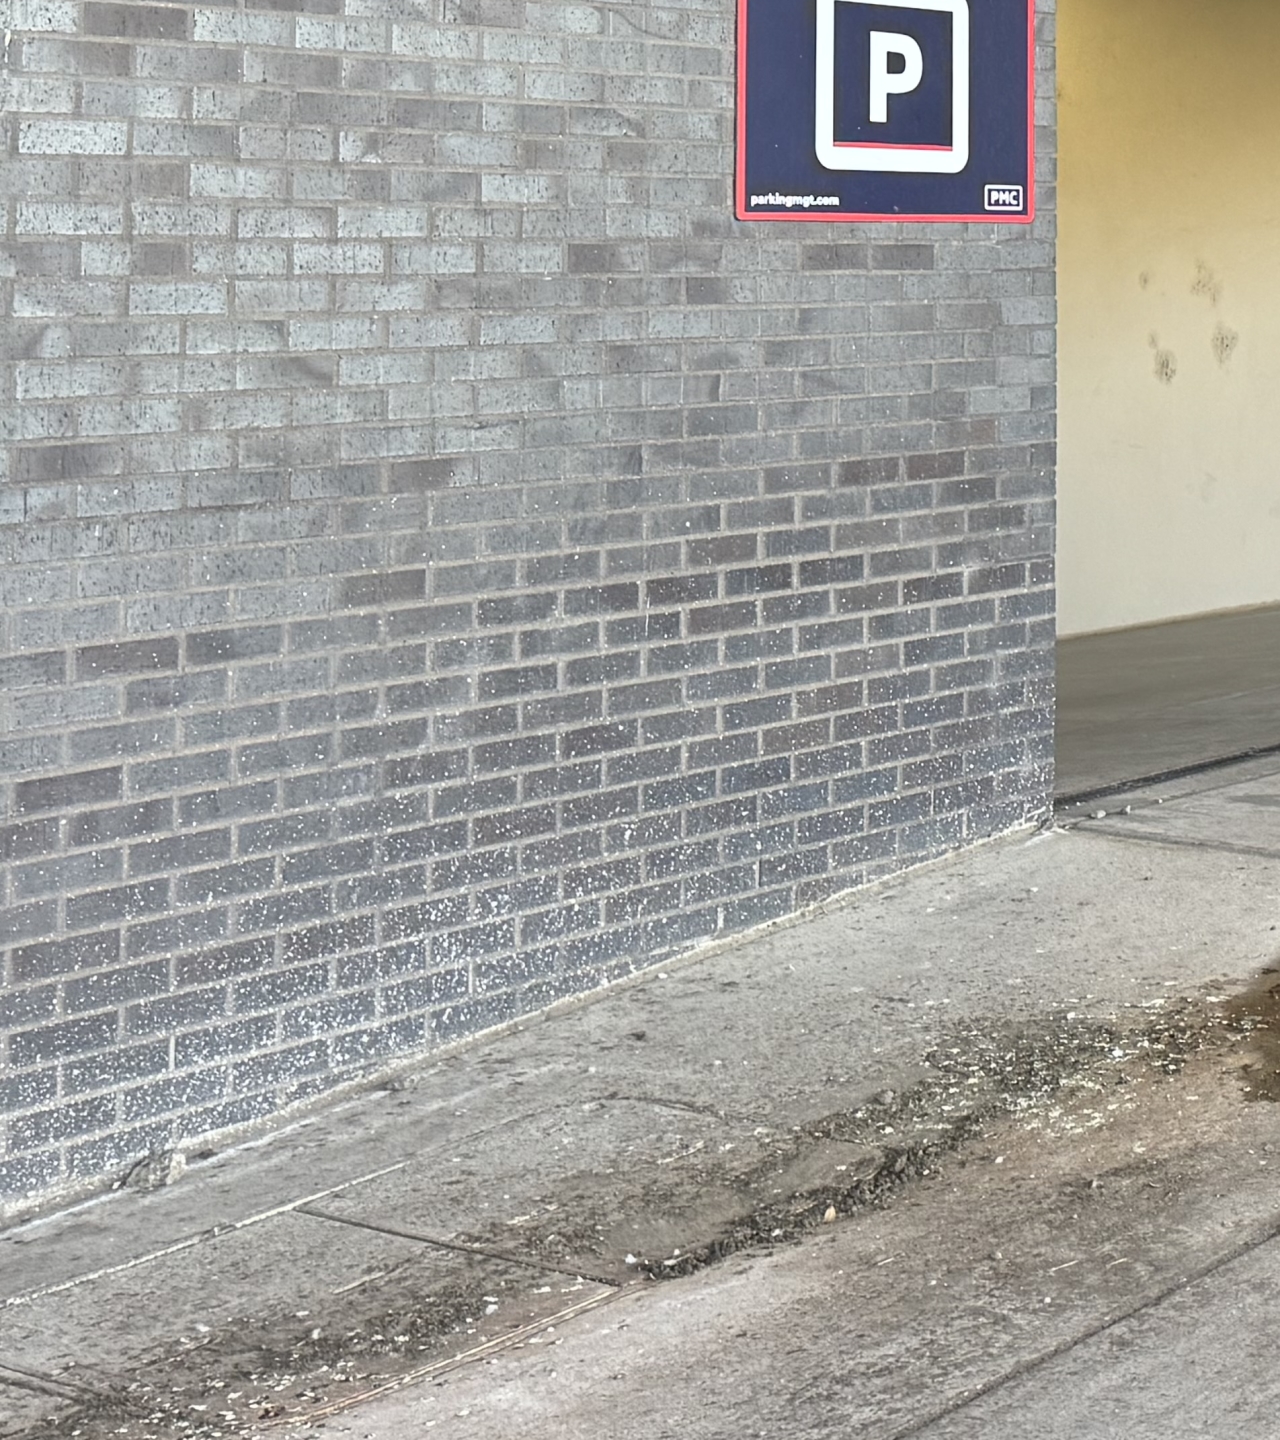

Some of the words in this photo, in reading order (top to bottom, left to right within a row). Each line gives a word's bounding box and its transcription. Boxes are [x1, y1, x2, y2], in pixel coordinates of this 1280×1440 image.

[869, 30, 924, 123] P
[750, 192, 840, 208] parkingmgt.com
[990, 190, 1018, 206] PMC
